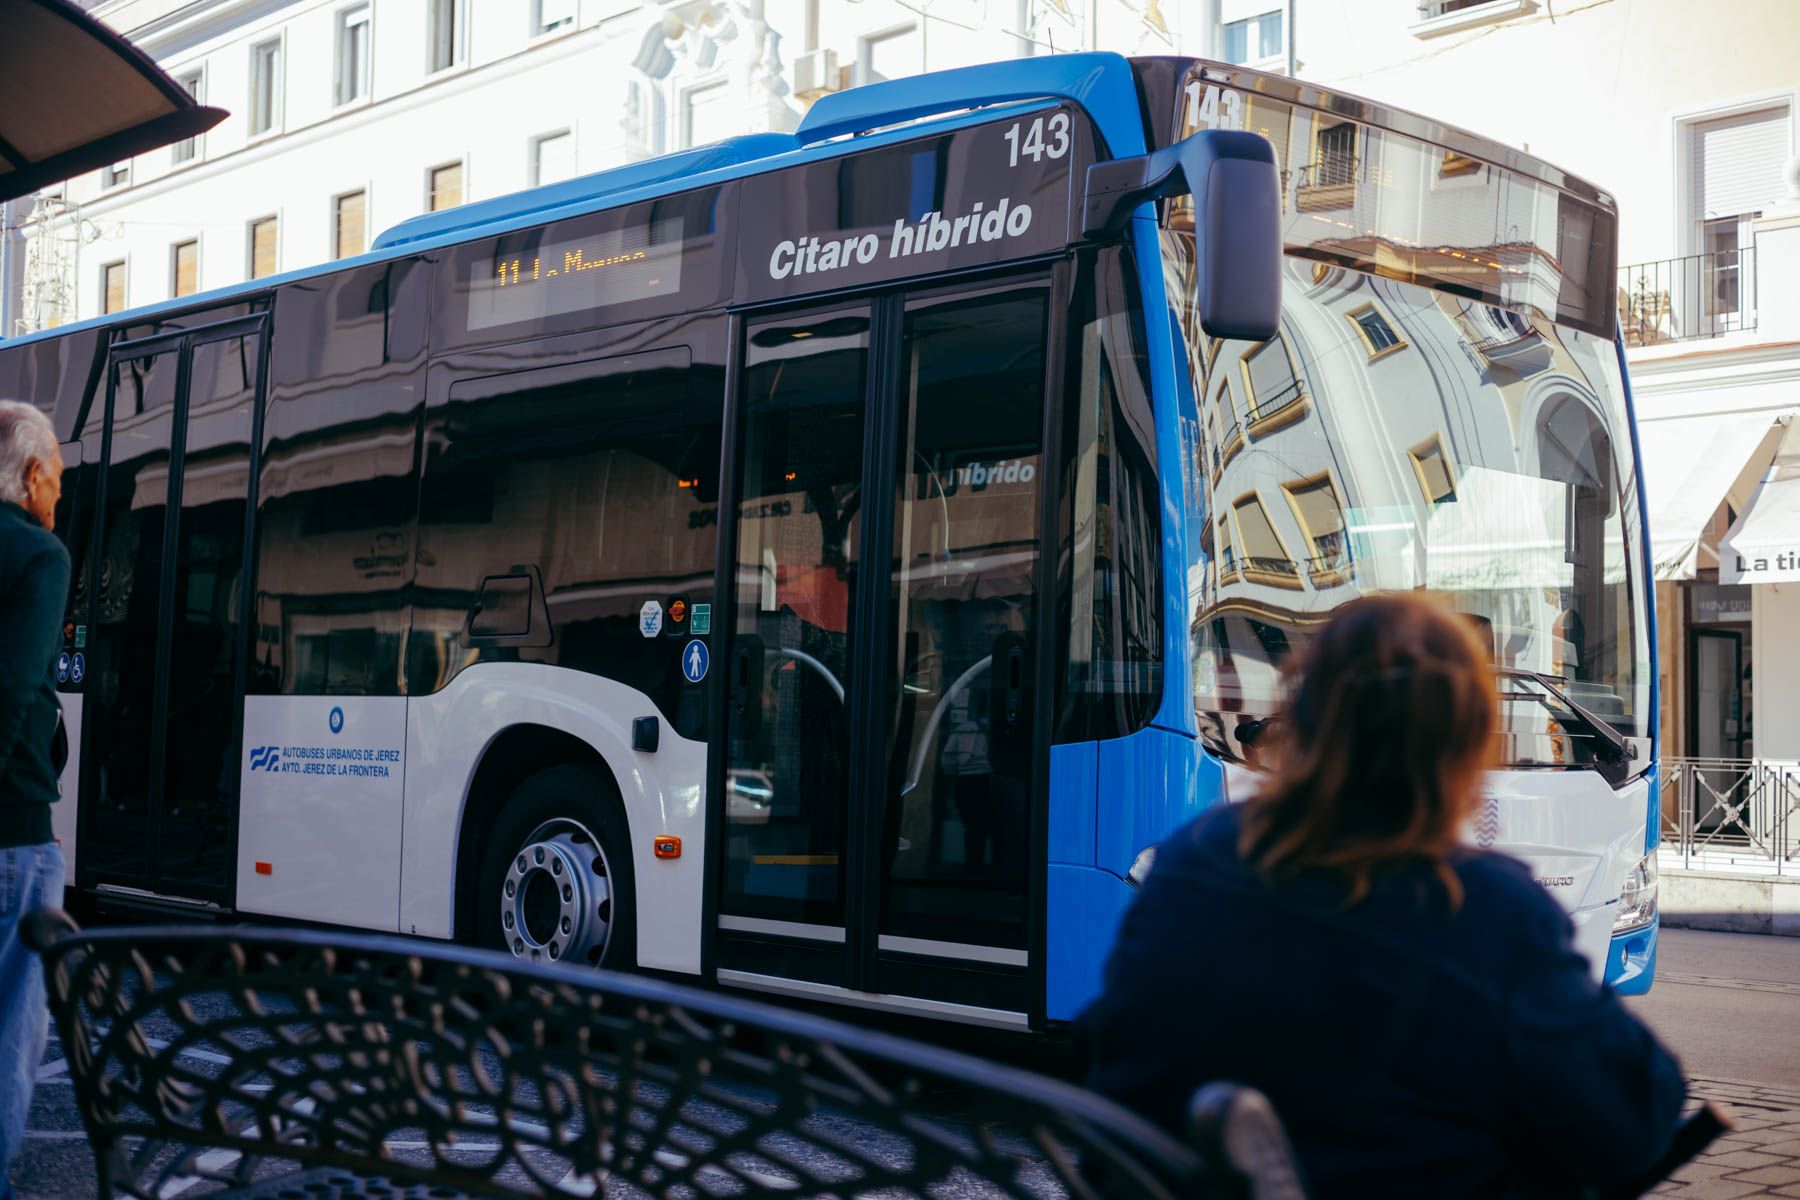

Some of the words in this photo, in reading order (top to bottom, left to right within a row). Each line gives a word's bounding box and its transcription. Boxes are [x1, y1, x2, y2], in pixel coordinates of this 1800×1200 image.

[1184, 81, 1241, 130] 143
[1004, 113, 1070, 167] 143
[769, 234, 879, 280] Citaro
[889, 198, 1032, 259] híbrido
[498, 259, 520, 287] 11
[1736, 555, 1769, 573] La
[1776, 551, 1800, 571] ti
[282, 747, 325, 759] AUTOBUSES
[326, 748, 362, 760] URBANOS
[363, 750, 374, 760] DE
[375, 750, 400, 761] JEREZ
[303, 763, 326, 774] JEREZ
[326, 764, 337, 775] DE
[338, 765, 348, 776] LA
[348, 765, 389, 777] FRONTERA
[1543, 876, 1575, 887] TARO
